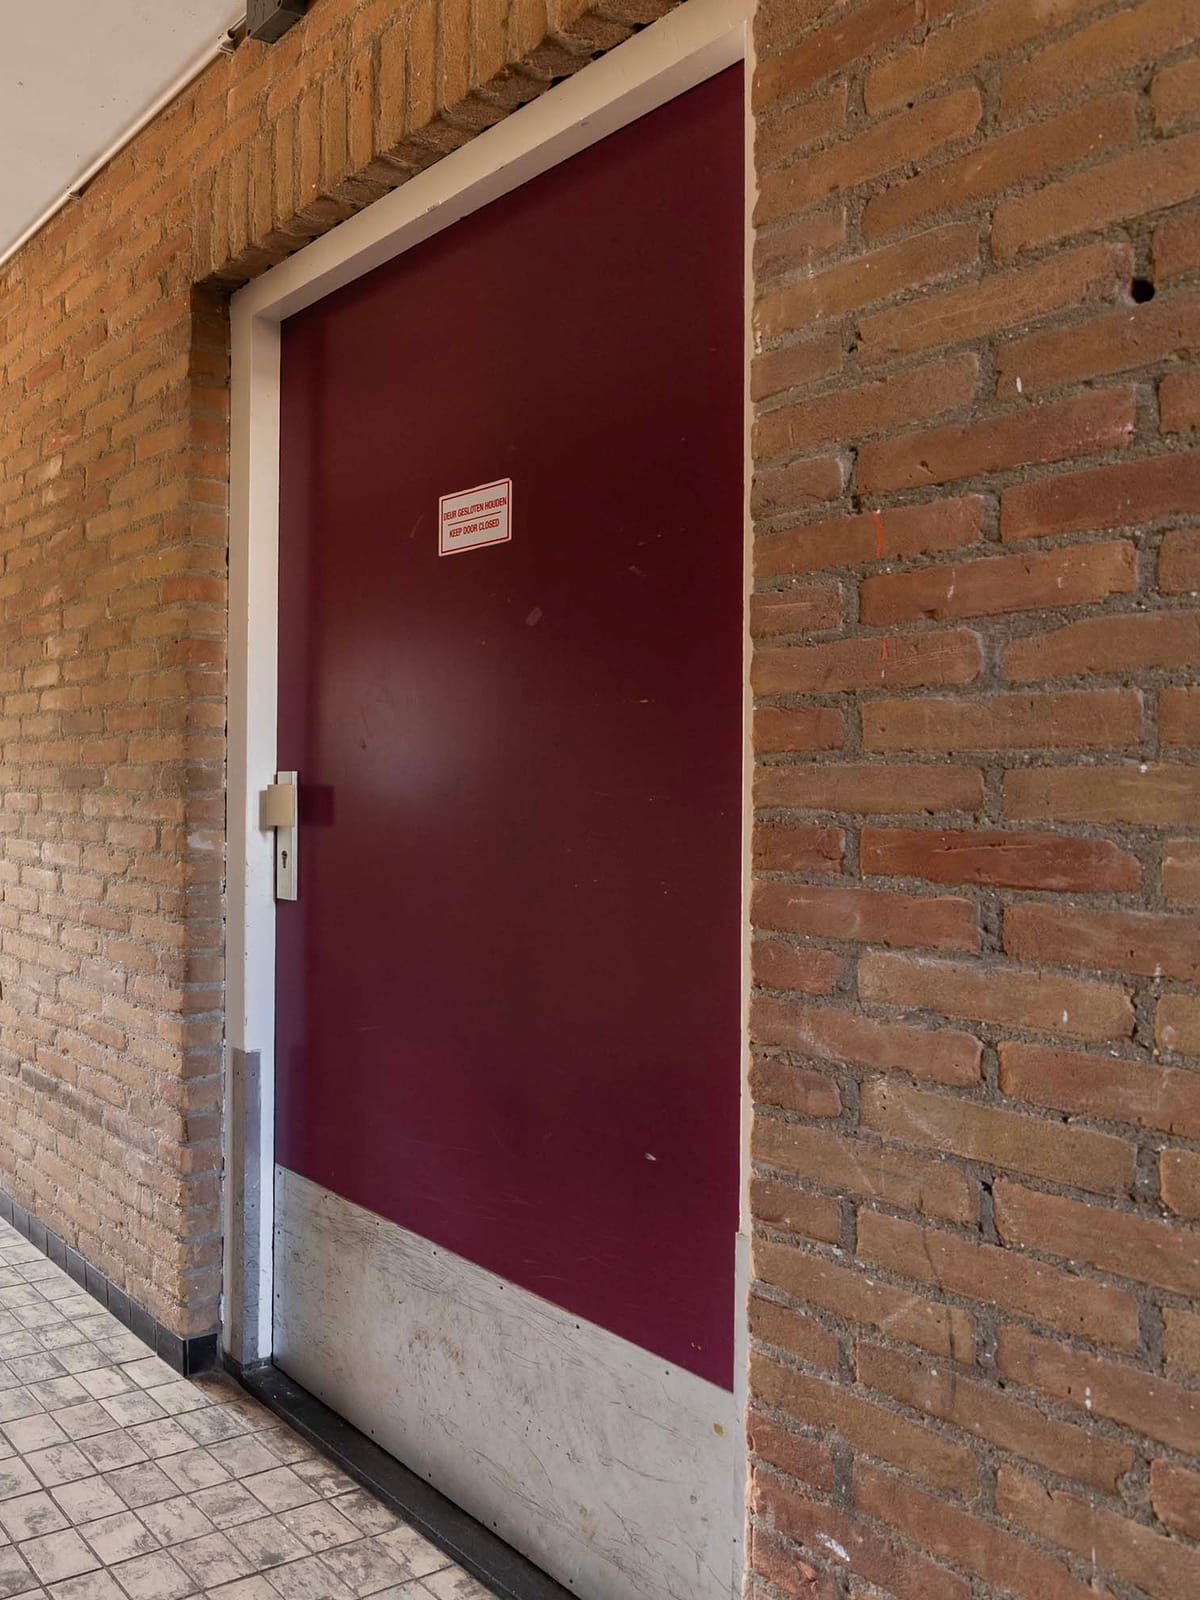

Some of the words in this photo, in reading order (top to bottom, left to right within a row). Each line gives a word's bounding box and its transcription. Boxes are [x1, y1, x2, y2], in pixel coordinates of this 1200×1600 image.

[443, 510, 456, 520] DEUR
[458, 503, 484, 517] GESLOTEN
[485, 497, 506, 510] HOUDEN
[449, 528, 462, 538] KEEP
[463, 524, 477, 535] DOOR
[479, 518, 499, 530] CLOSED
